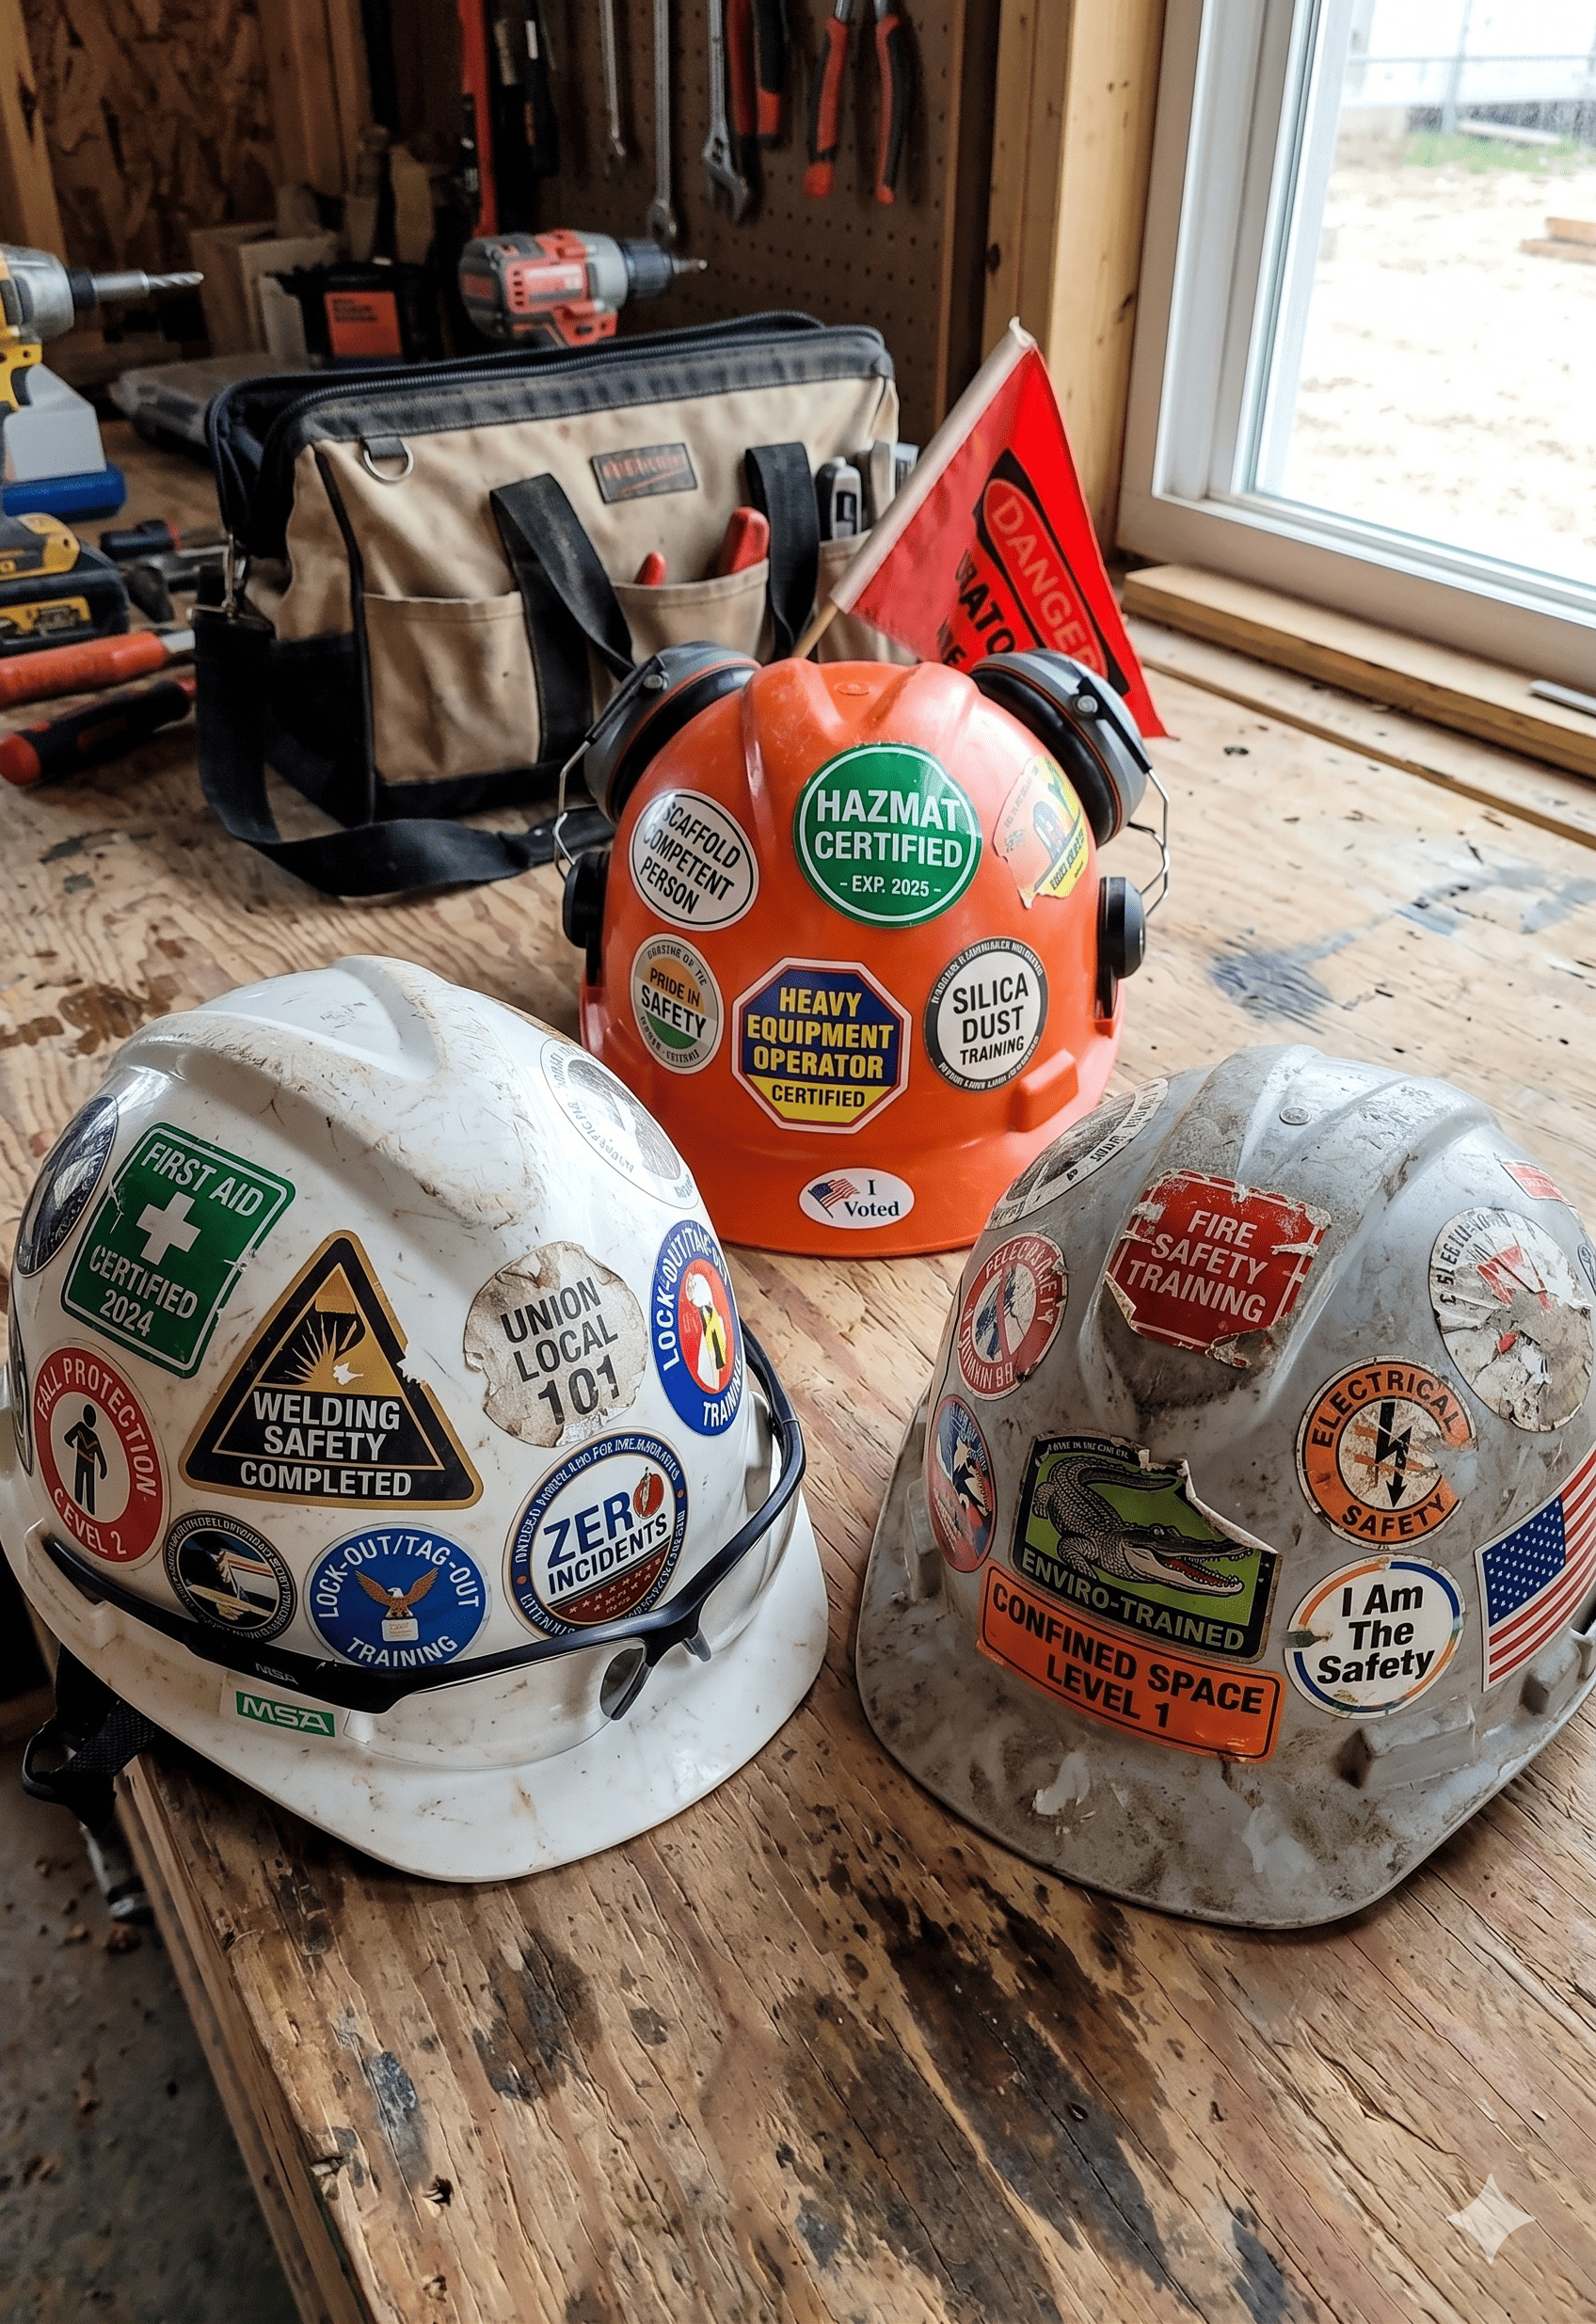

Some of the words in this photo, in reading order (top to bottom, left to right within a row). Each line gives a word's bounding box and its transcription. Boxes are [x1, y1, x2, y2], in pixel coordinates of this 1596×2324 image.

[817, 789, 960, 831] HAZMAT
[662, 802, 741, 868] SCAFFOLD
[814, 831, 963, 868] CERTIFIED
[643, 822, 735, 900] COMPETENT
[640, 856, 700, 915] PERSON
[852, 875, 886, 893] EXP.
[891, 879, 930, 897] 2025
[649, 967, 685, 999] PRIDE
[687, 988, 701, 1008] IN
[779, 987, 862, 1017] HEAVY
[952, 972, 1029, 1014] SILICA
[641, 984, 707, 1039] SAFETY
[747, 1013, 894, 1049] EQUIPMENT
[963, 1005, 1025, 1043] DUST
[754, 1045, 884, 1079] OPERATOR
[960, 1035, 1024, 1065] TRAINING
[772, 1084, 865, 1107] CERTIFIED
[141, 1141, 217, 1192] FIRST
[208, 1176, 264, 1217] AID
[867, 1179, 876, 1195] I
[843, 1201, 900, 1217] Voted
[1187, 1209, 1257, 1248] FIRE
[1151, 1234, 1269, 1284] SAFETY
[89, 1244, 198, 1319] CERTIFIED
[1126, 1259, 1266, 1323] TRAINING
[99, 1289, 154, 1337] 2024
[500, 1277, 601, 1344] UNION
[513, 1314, 618, 1382] LOCAL
[253, 1391, 400, 1429] WELDING
[537, 1354, 620, 1425] 101
[1311, 1370, 1460, 1448] ELECTRICAL
[37, 1366, 63, 1421] FALL
[63, 1358, 157, 1497] PROTECTION
[263, 1425, 387, 1460] SAFETY
[240, 1461, 412, 1496] COMPLETED
[1341, 1493, 1445, 1536] SAFETY
[110, 1530, 127, 1555] 2
[548, 1512, 668, 1595] INCIDENTS
[316, 1536, 480, 1618] LOCK-OUT/TAG-OUT
[1022, 1548, 1244, 1649] ENVIRO-TRAINED
[1341, 1587, 1353, 1617] I
[1363, 1584, 1424, 1616] Am
[346, 1635, 458, 1667] TRAINING
[993, 1583, 1137, 1680] CONFINED
[1147, 1663, 1265, 1715] SPACE
[1348, 1619, 1414, 1650] The
[1317, 1648, 1436, 1684] Safety
[1046, 1653, 1141, 1720] LEVEL
[1155, 1702, 1171, 1727] 1
[242, 1696, 330, 1733] MSA
